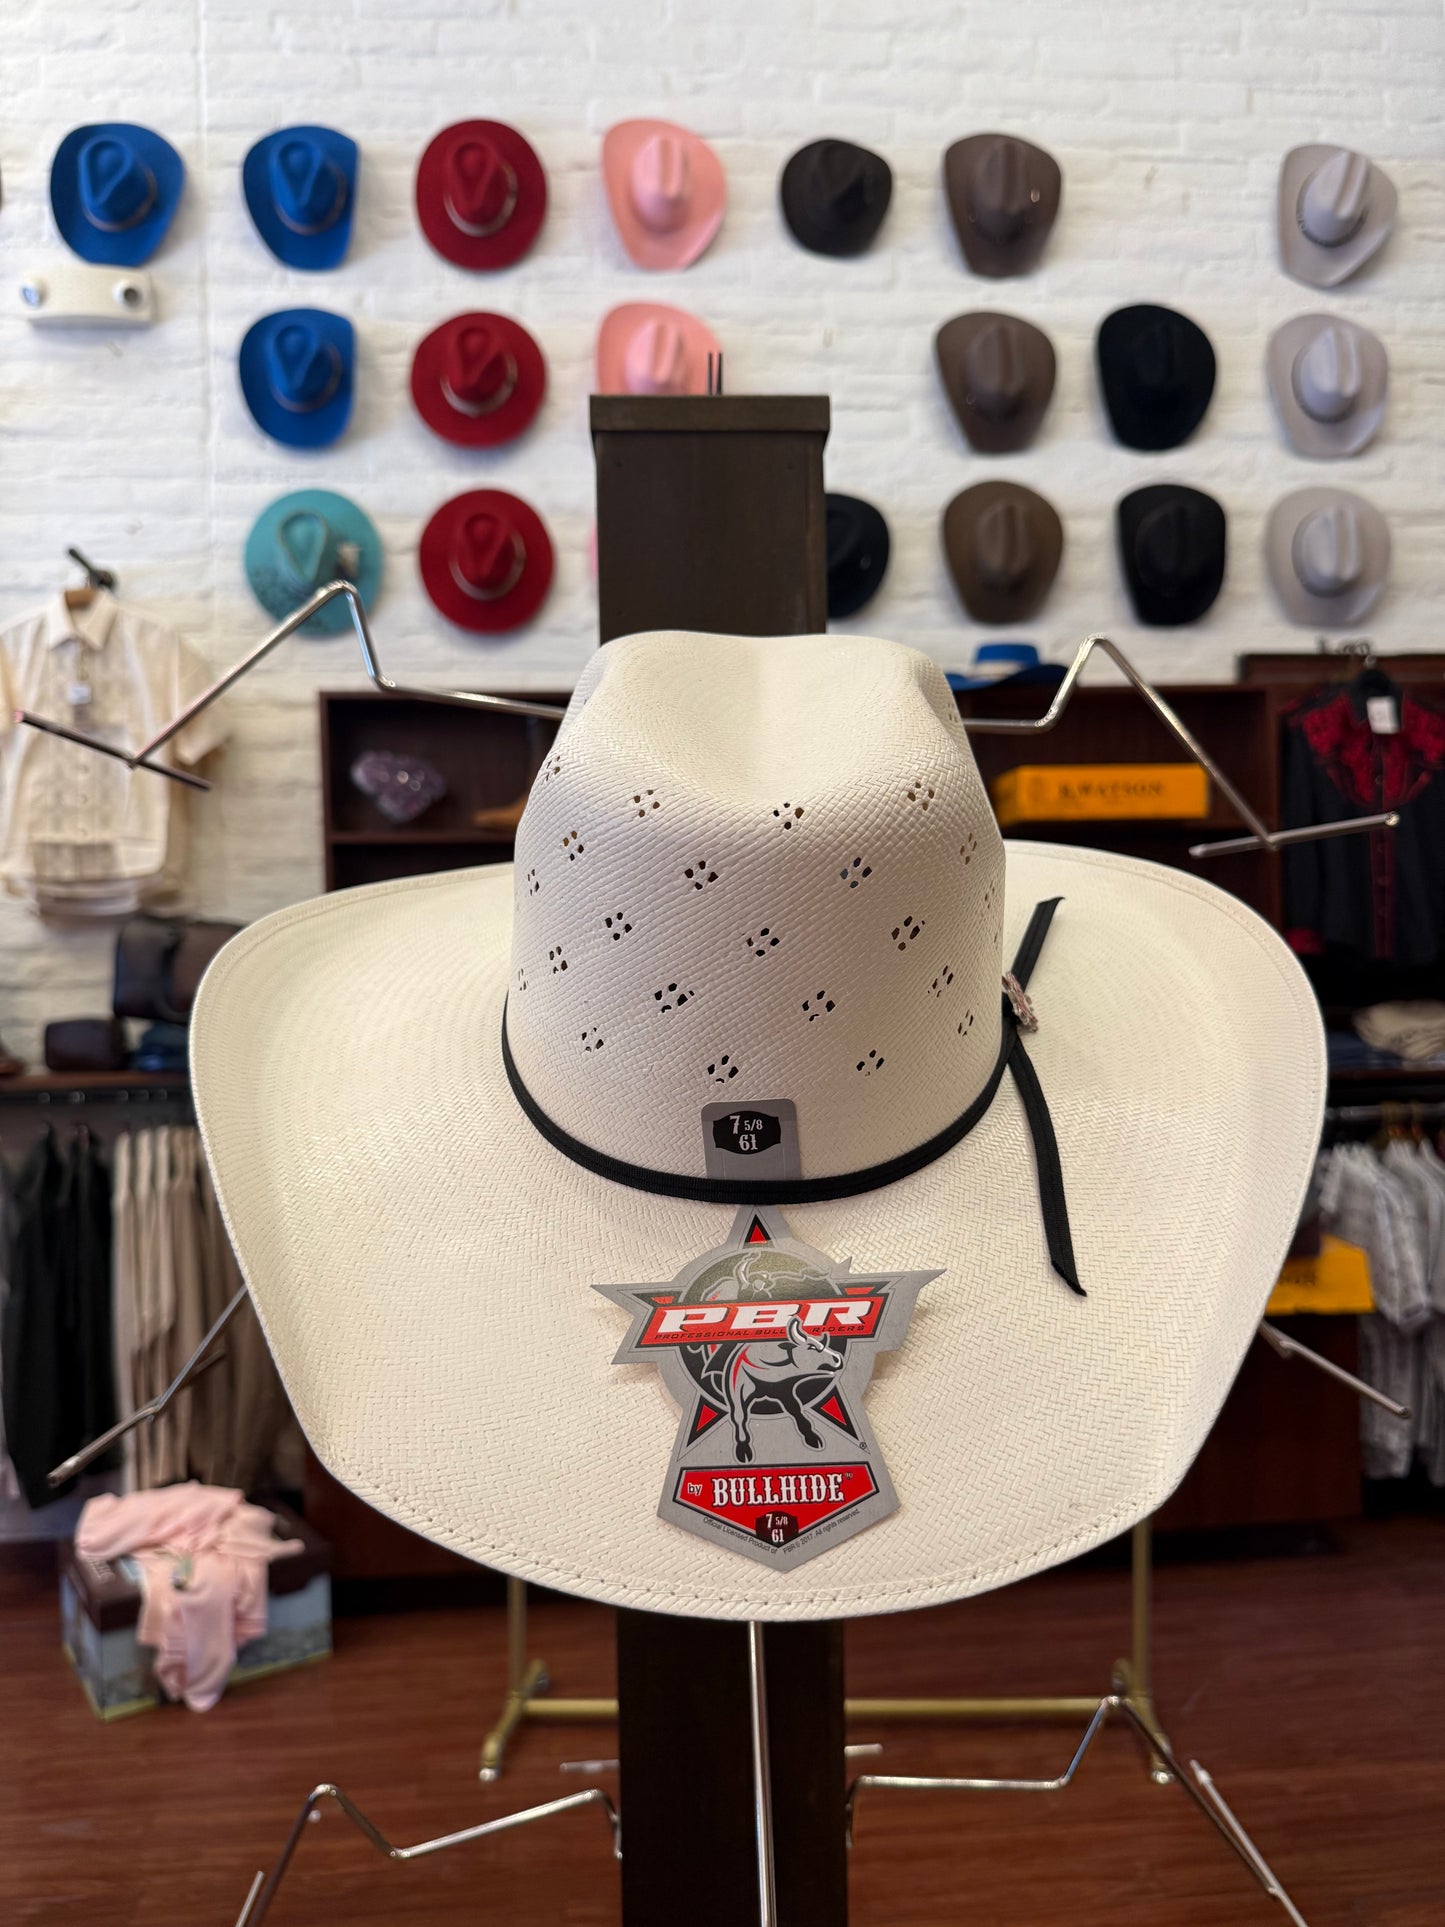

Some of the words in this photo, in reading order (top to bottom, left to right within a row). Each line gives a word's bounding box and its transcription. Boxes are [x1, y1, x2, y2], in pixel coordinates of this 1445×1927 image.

[729, 1115, 741, 1135] 7
[744, 1118, 763, 1131] 5/8
[738, 1134, 758, 1151] 61
[657, 1300, 873, 1333] PBR
[654, 1330, 749, 1341] PROFESSIONAL
[755, 1327, 787, 1336] BULL
[811, 1324, 865, 1333] RIDERS
[687, 1482, 702, 1497] by
[711, 1473, 845, 1507] BULLHIDE
[765, 1513, 773, 1529] 7
[775, 1516, 788, 1526] 5/8
[703, 1516, 723, 1530] Official
[722, 1525, 748, 1542] Licensed
[748, 1536, 771, 1552] Product
[822, 1520, 838, 1533] rights
[771, 1529, 785, 1543] 61
